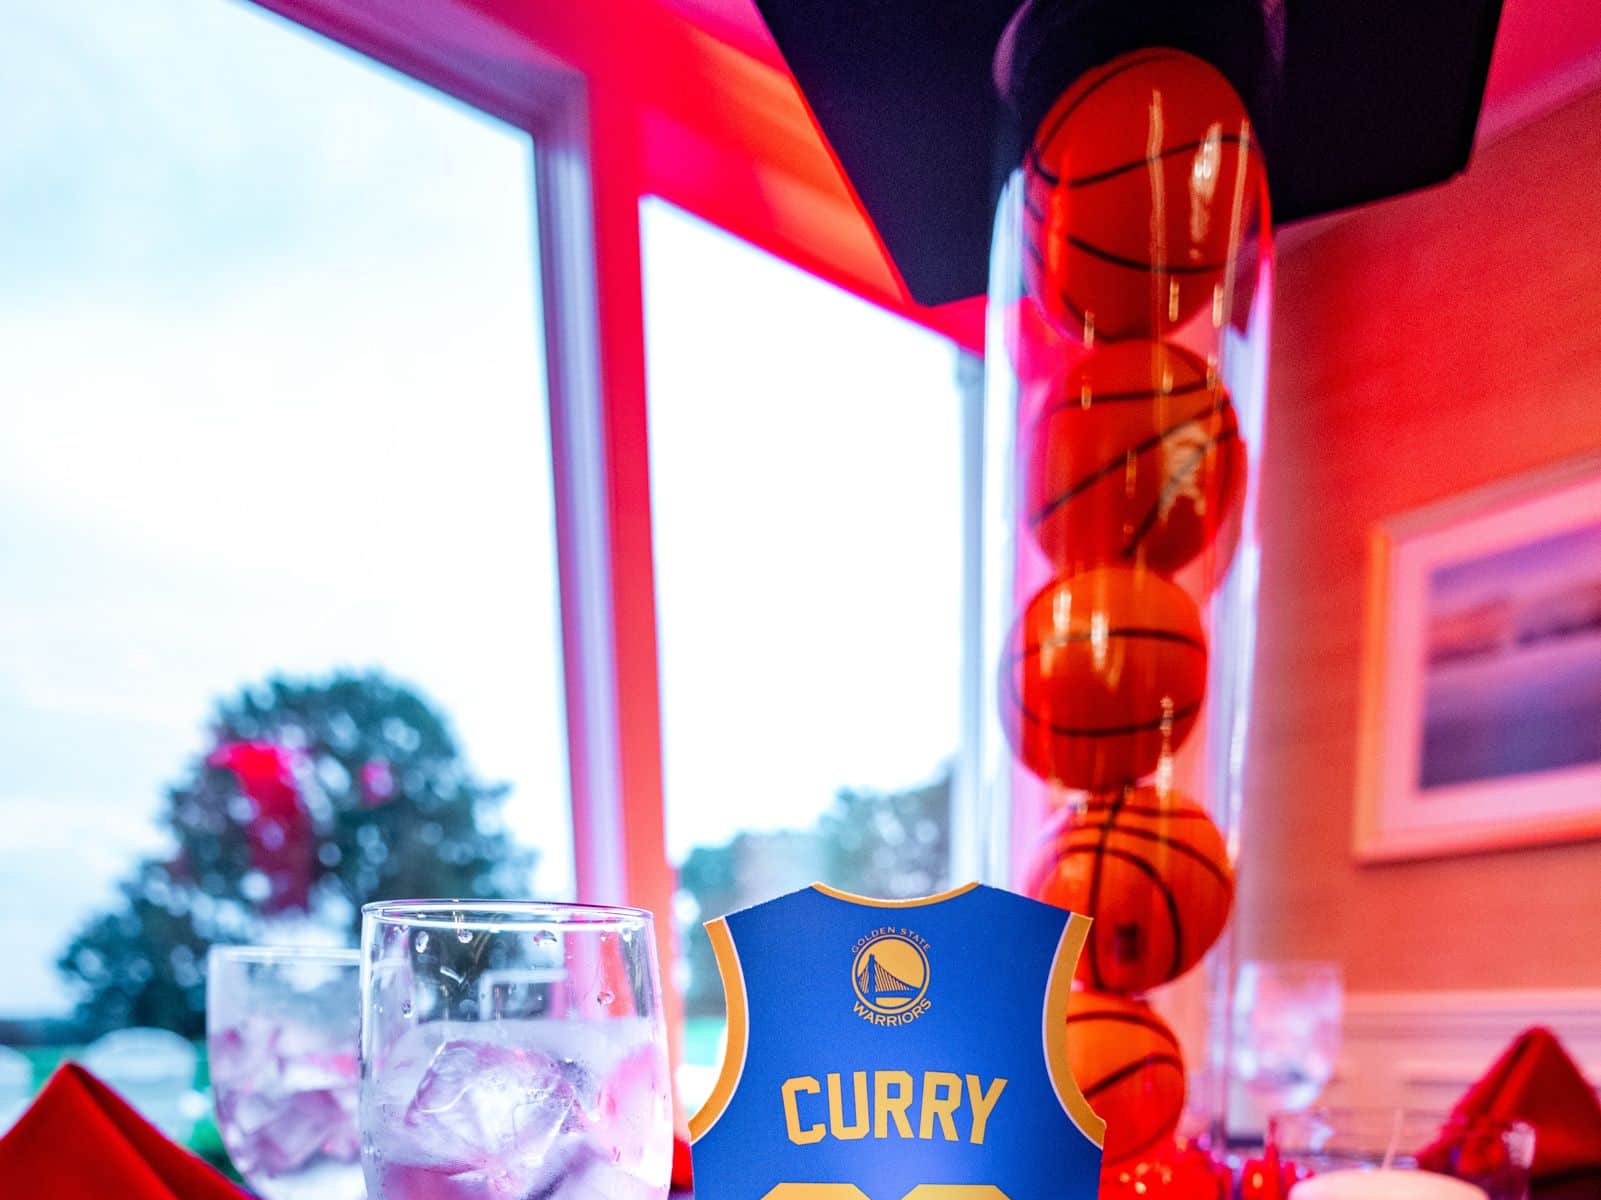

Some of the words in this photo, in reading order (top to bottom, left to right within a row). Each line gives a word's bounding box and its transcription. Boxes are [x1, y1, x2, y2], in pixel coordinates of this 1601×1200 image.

[851, 927, 896, 953] GOLDEN
[900, 927, 931, 952] STATE
[853, 998, 932, 1027] WARRIORS
[781, 1070, 1008, 1145] CURRY
